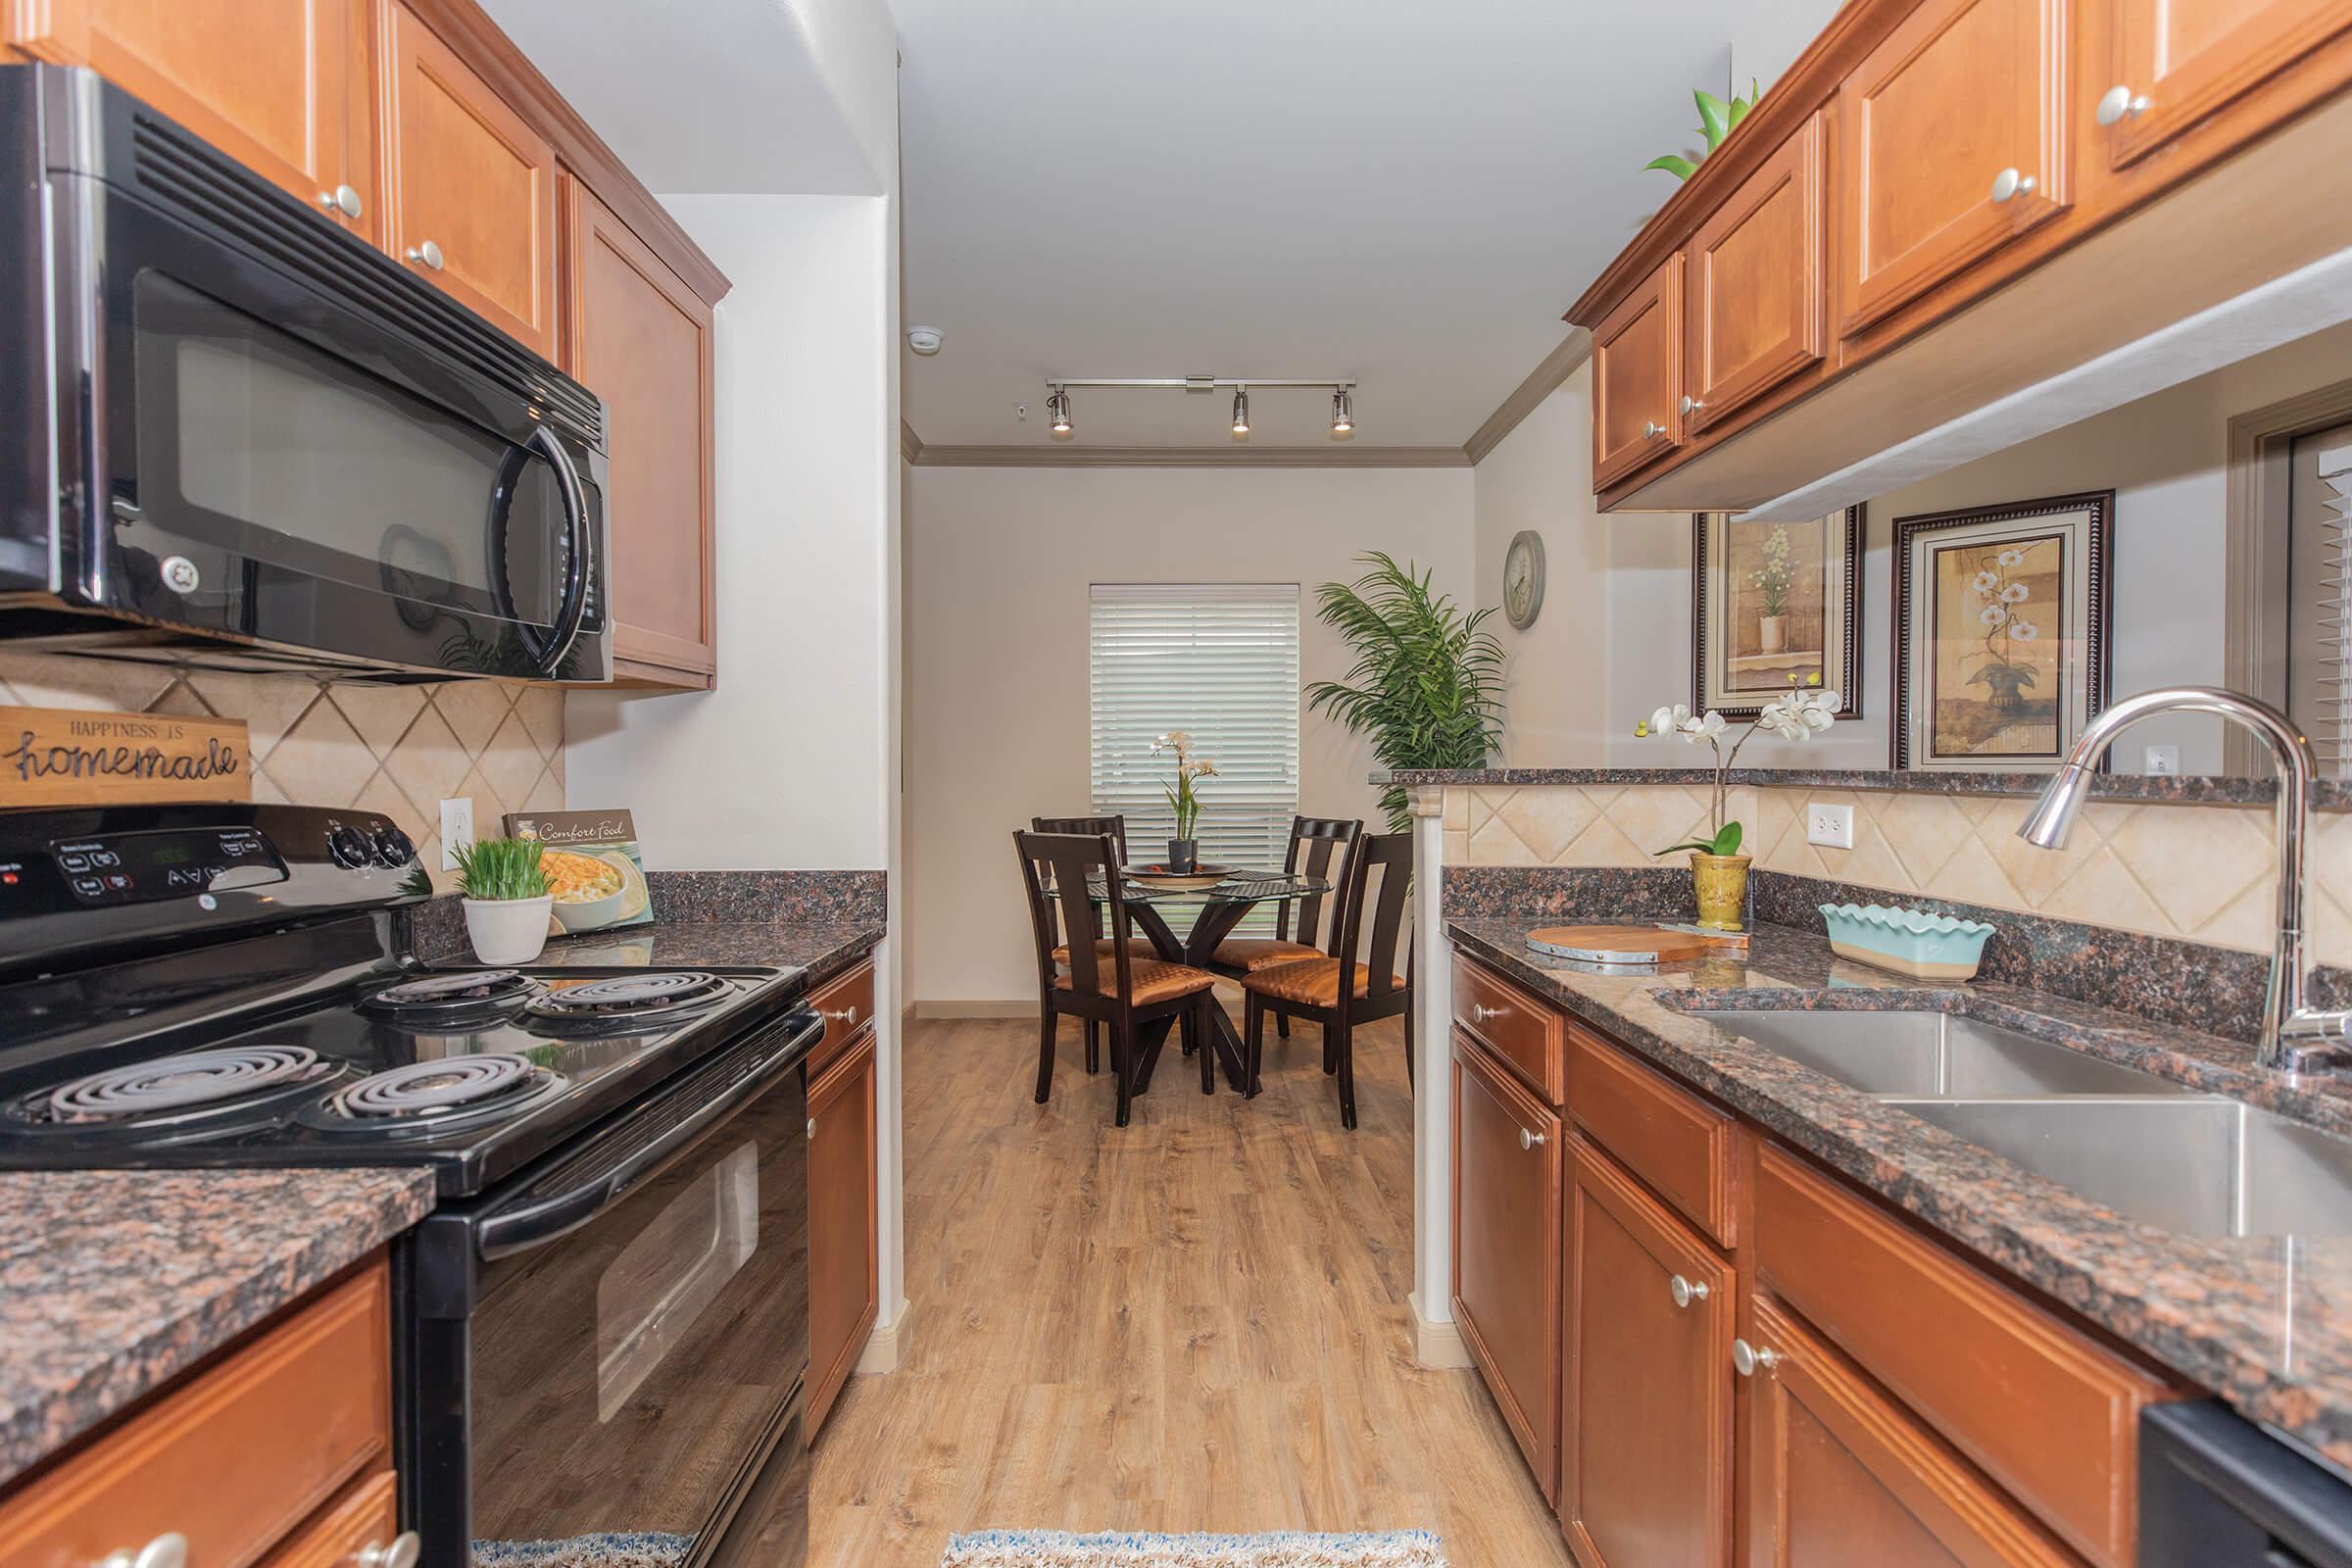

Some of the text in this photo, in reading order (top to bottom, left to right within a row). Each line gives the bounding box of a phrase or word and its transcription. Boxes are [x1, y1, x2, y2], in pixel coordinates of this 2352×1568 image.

[70, 720, 184, 740] HAPPINESS IS
[2, 730, 238, 782] homemade
[539, 819, 625, 842] Comfort Food
